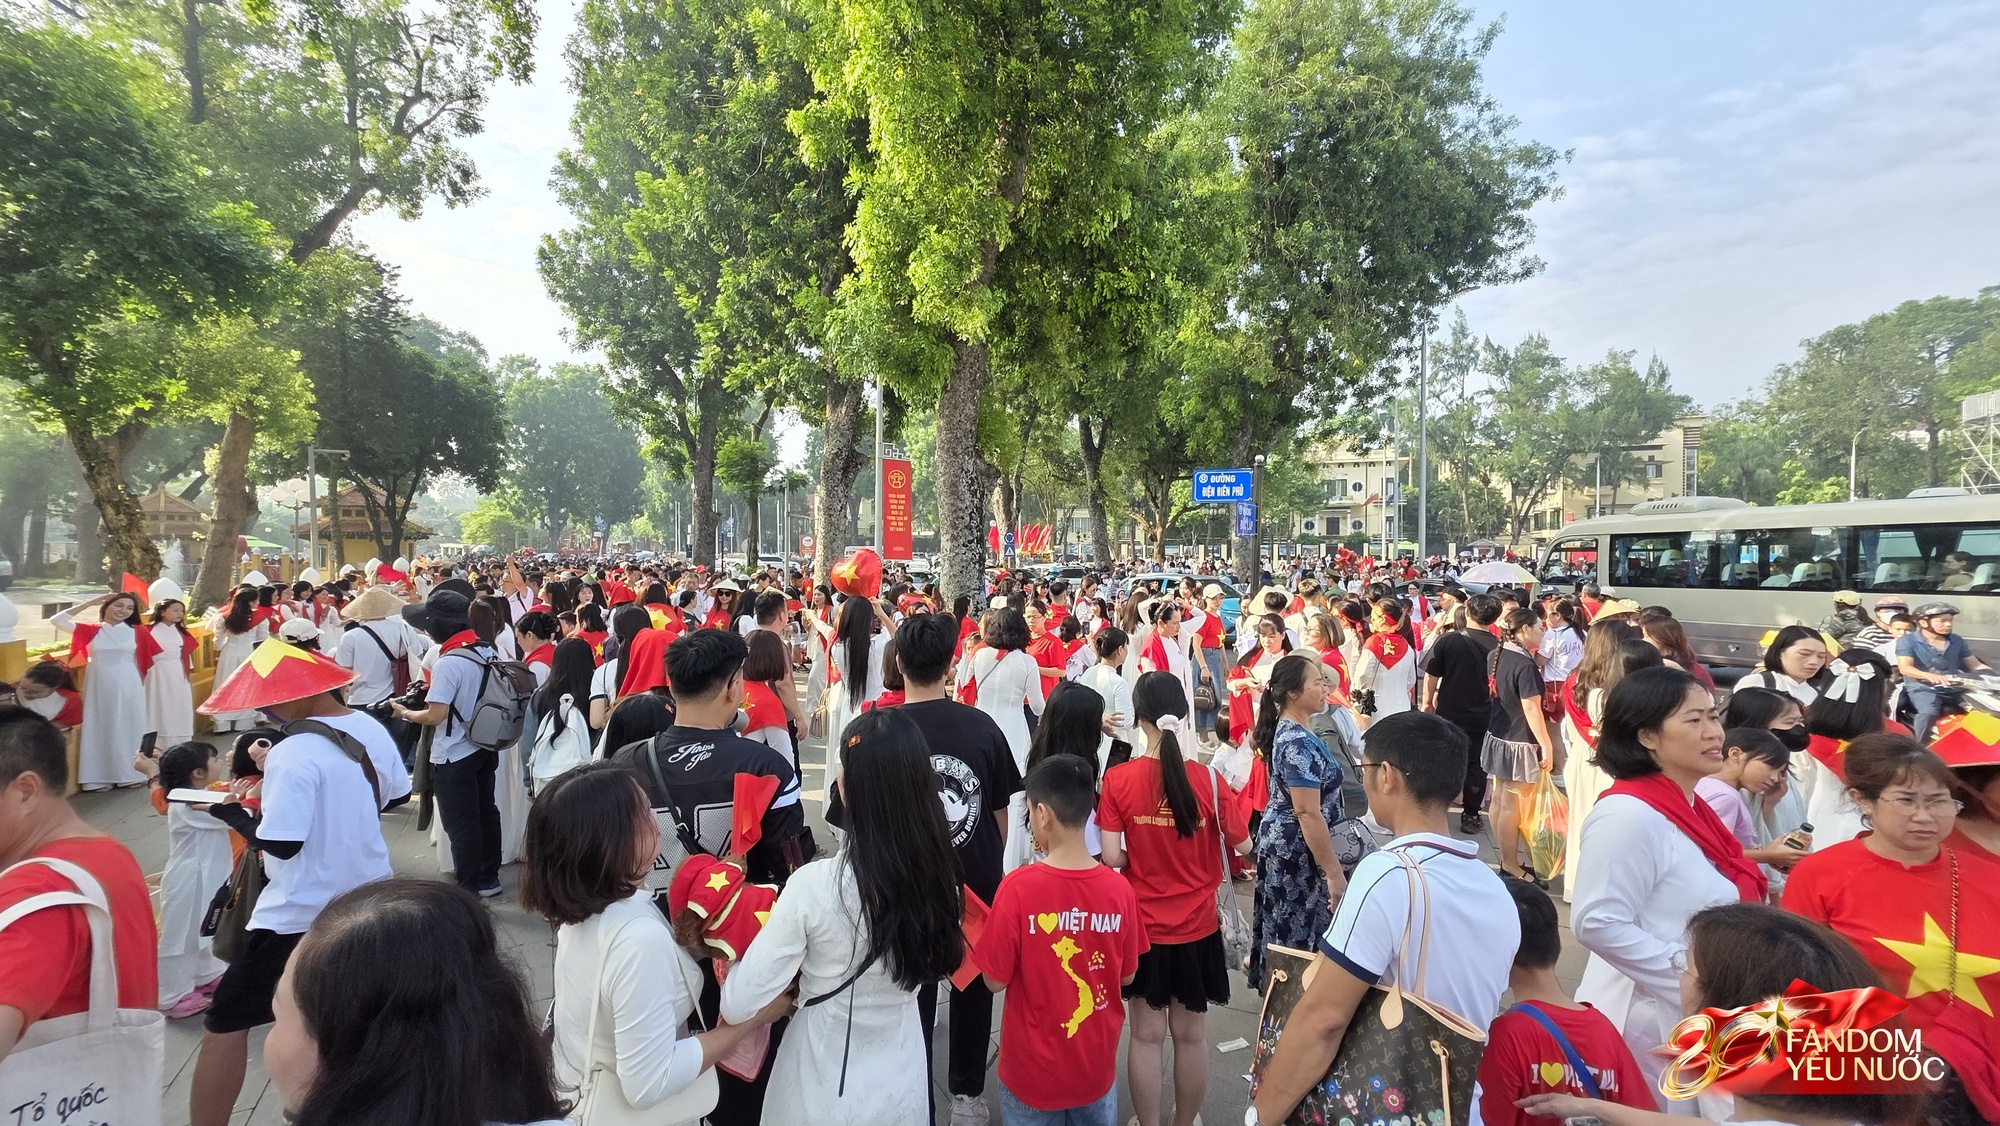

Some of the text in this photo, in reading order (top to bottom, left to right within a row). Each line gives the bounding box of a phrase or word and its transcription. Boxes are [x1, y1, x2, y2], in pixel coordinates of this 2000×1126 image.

[1210, 473, 1236, 483] ĐƯỜNG
[1202, 483, 1244, 498] ĐIỆN BIÊN PHỦ
[1028, 914, 1036, 934] I
[1057, 906, 1089, 935] VIỆT
[9, 1082, 109, 1126] Tổ quốc
